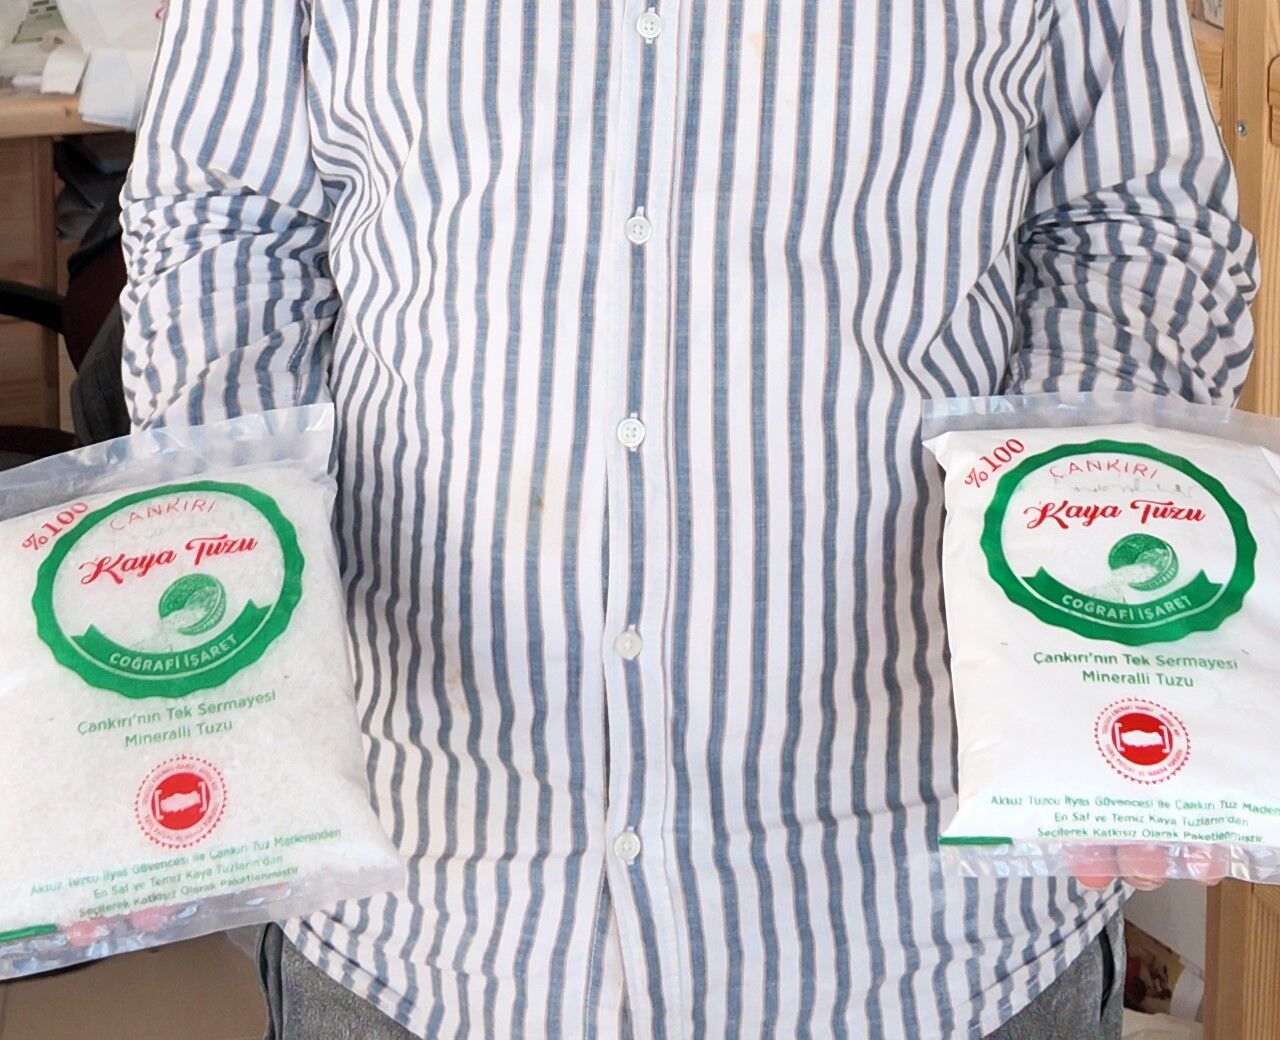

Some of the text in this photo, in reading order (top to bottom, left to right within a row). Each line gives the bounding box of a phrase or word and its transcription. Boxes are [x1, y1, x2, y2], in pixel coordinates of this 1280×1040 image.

[964, 438, 1025, 488] %100
[21, 502, 89, 551] %100
[1023, 499, 1206, 530] Kaya Tuzu
[78, 534, 258, 585] Kaya Tuzu
[1061, 594, 1193, 621] COĞRAFİ İŞARET
[109, 633, 238, 673] COĞRAFİ İŞARET
[1033, 651, 1239, 671] Çankırı'nın Tek Sermayesi
[1082, 670, 1194, 687] Mineralli Tuzu
[77, 689, 276, 736] Çankırı'nın Tek Sermayesi
[125, 720, 232, 748] Mineralli Tuzu
[1037, 827, 1088, 838] Seçilerek
[1093, 828, 1137, 838] Katkısız
[1142, 829, 1179, 839] Olarak
[1054, 812, 1068, 822] En
[1073, 812, 1090, 822] Saf
[1095, 814, 1106, 823] ve
[1112, 813, 1144, 823] Temiz
[1149, 815, 1177, 826] Kaya
[93, 888, 108, 900] En
[133, 881, 146, 891] ve
[150, 873, 182, 888] Temiz
[185, 867, 213, 881] Kaya
[181, 884, 216, 897] Olarak
